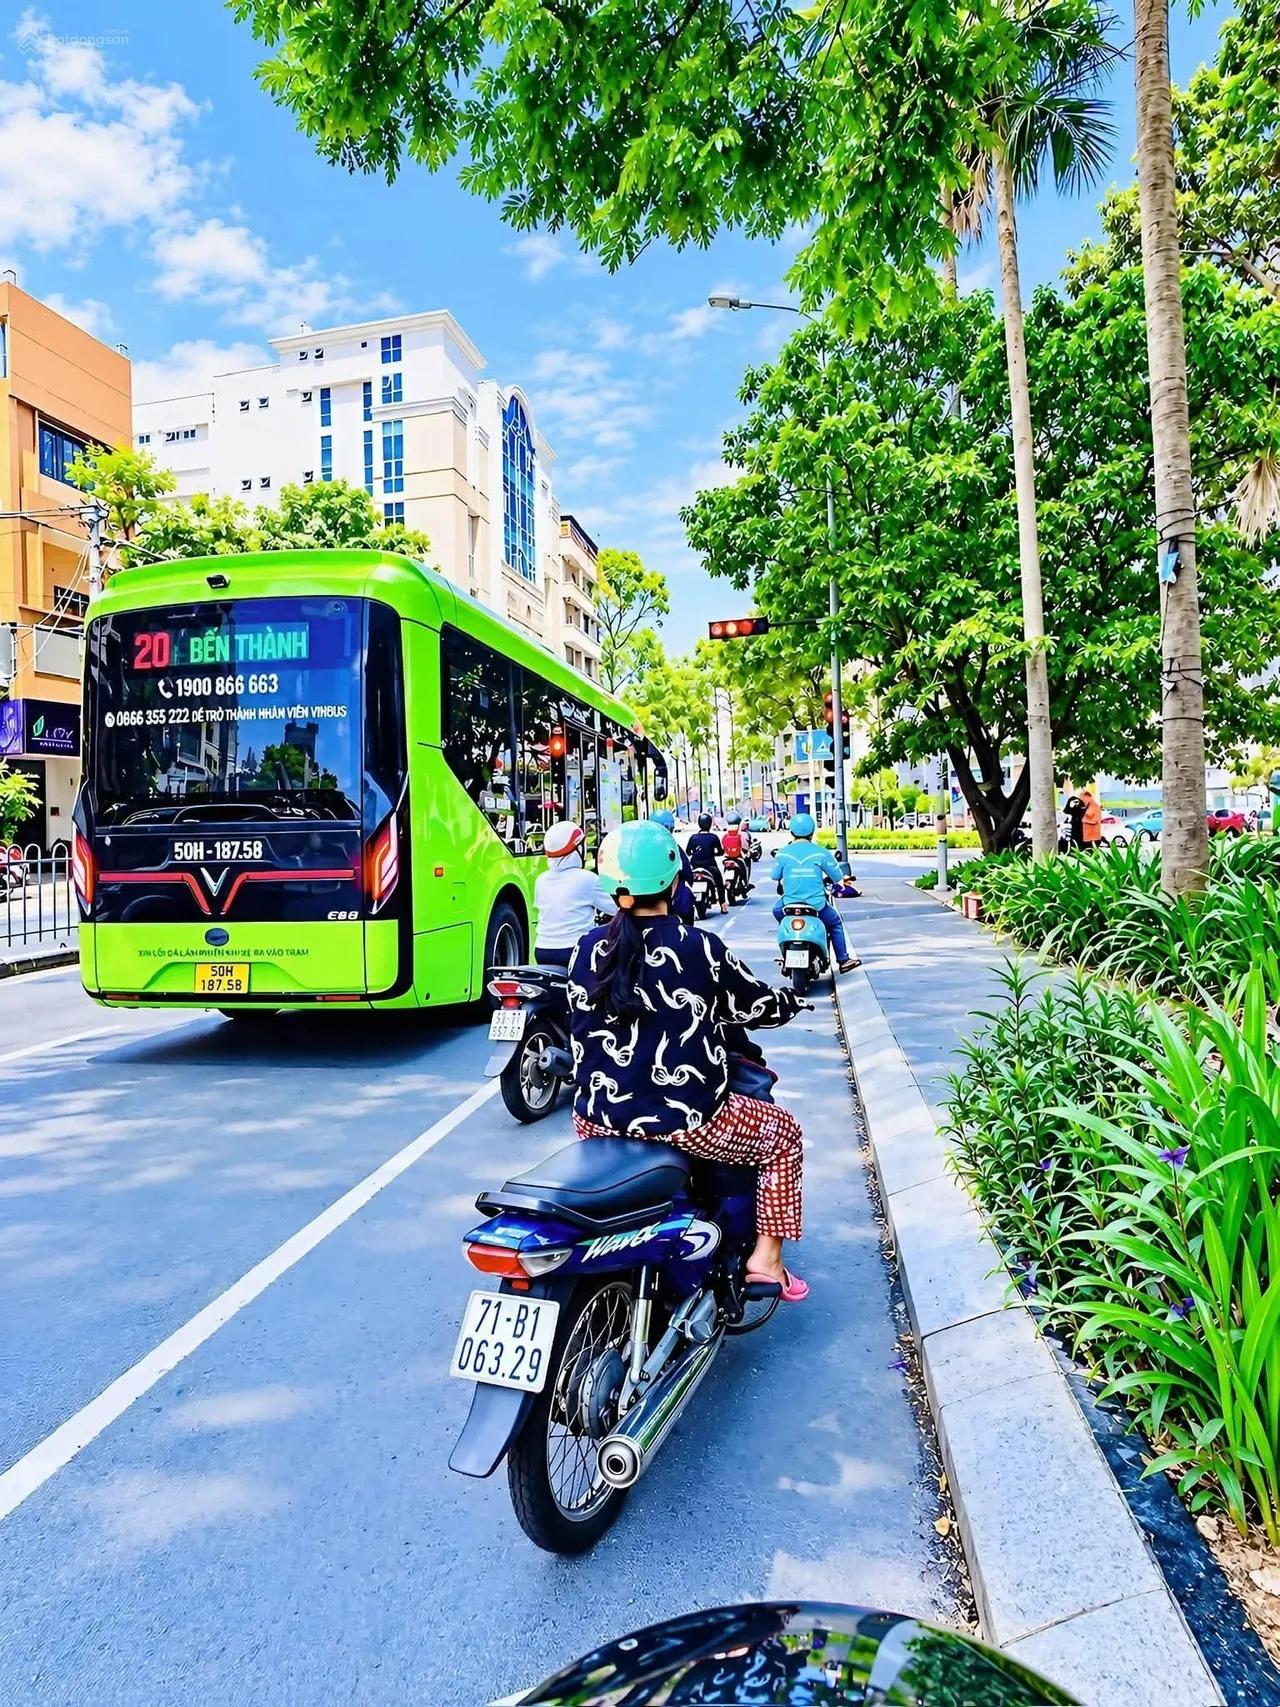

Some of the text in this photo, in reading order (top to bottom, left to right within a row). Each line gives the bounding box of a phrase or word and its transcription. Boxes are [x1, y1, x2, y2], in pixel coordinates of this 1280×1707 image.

[133, 631, 170, 669] 20
[190, 625, 307, 663] BẾN THÀNH
[176, 673, 279, 697] 1900 866 663
[116, 710, 144, 726] 0866
[145, 708, 167, 725] 355
[168, 707, 190, 724] 222
[201, 979, 242, 991] 187.58
[210, 965, 234, 977] 50H
[474, 1299, 541, 1341] 71-B1
[458, 1337, 542, 1383] 063.29
